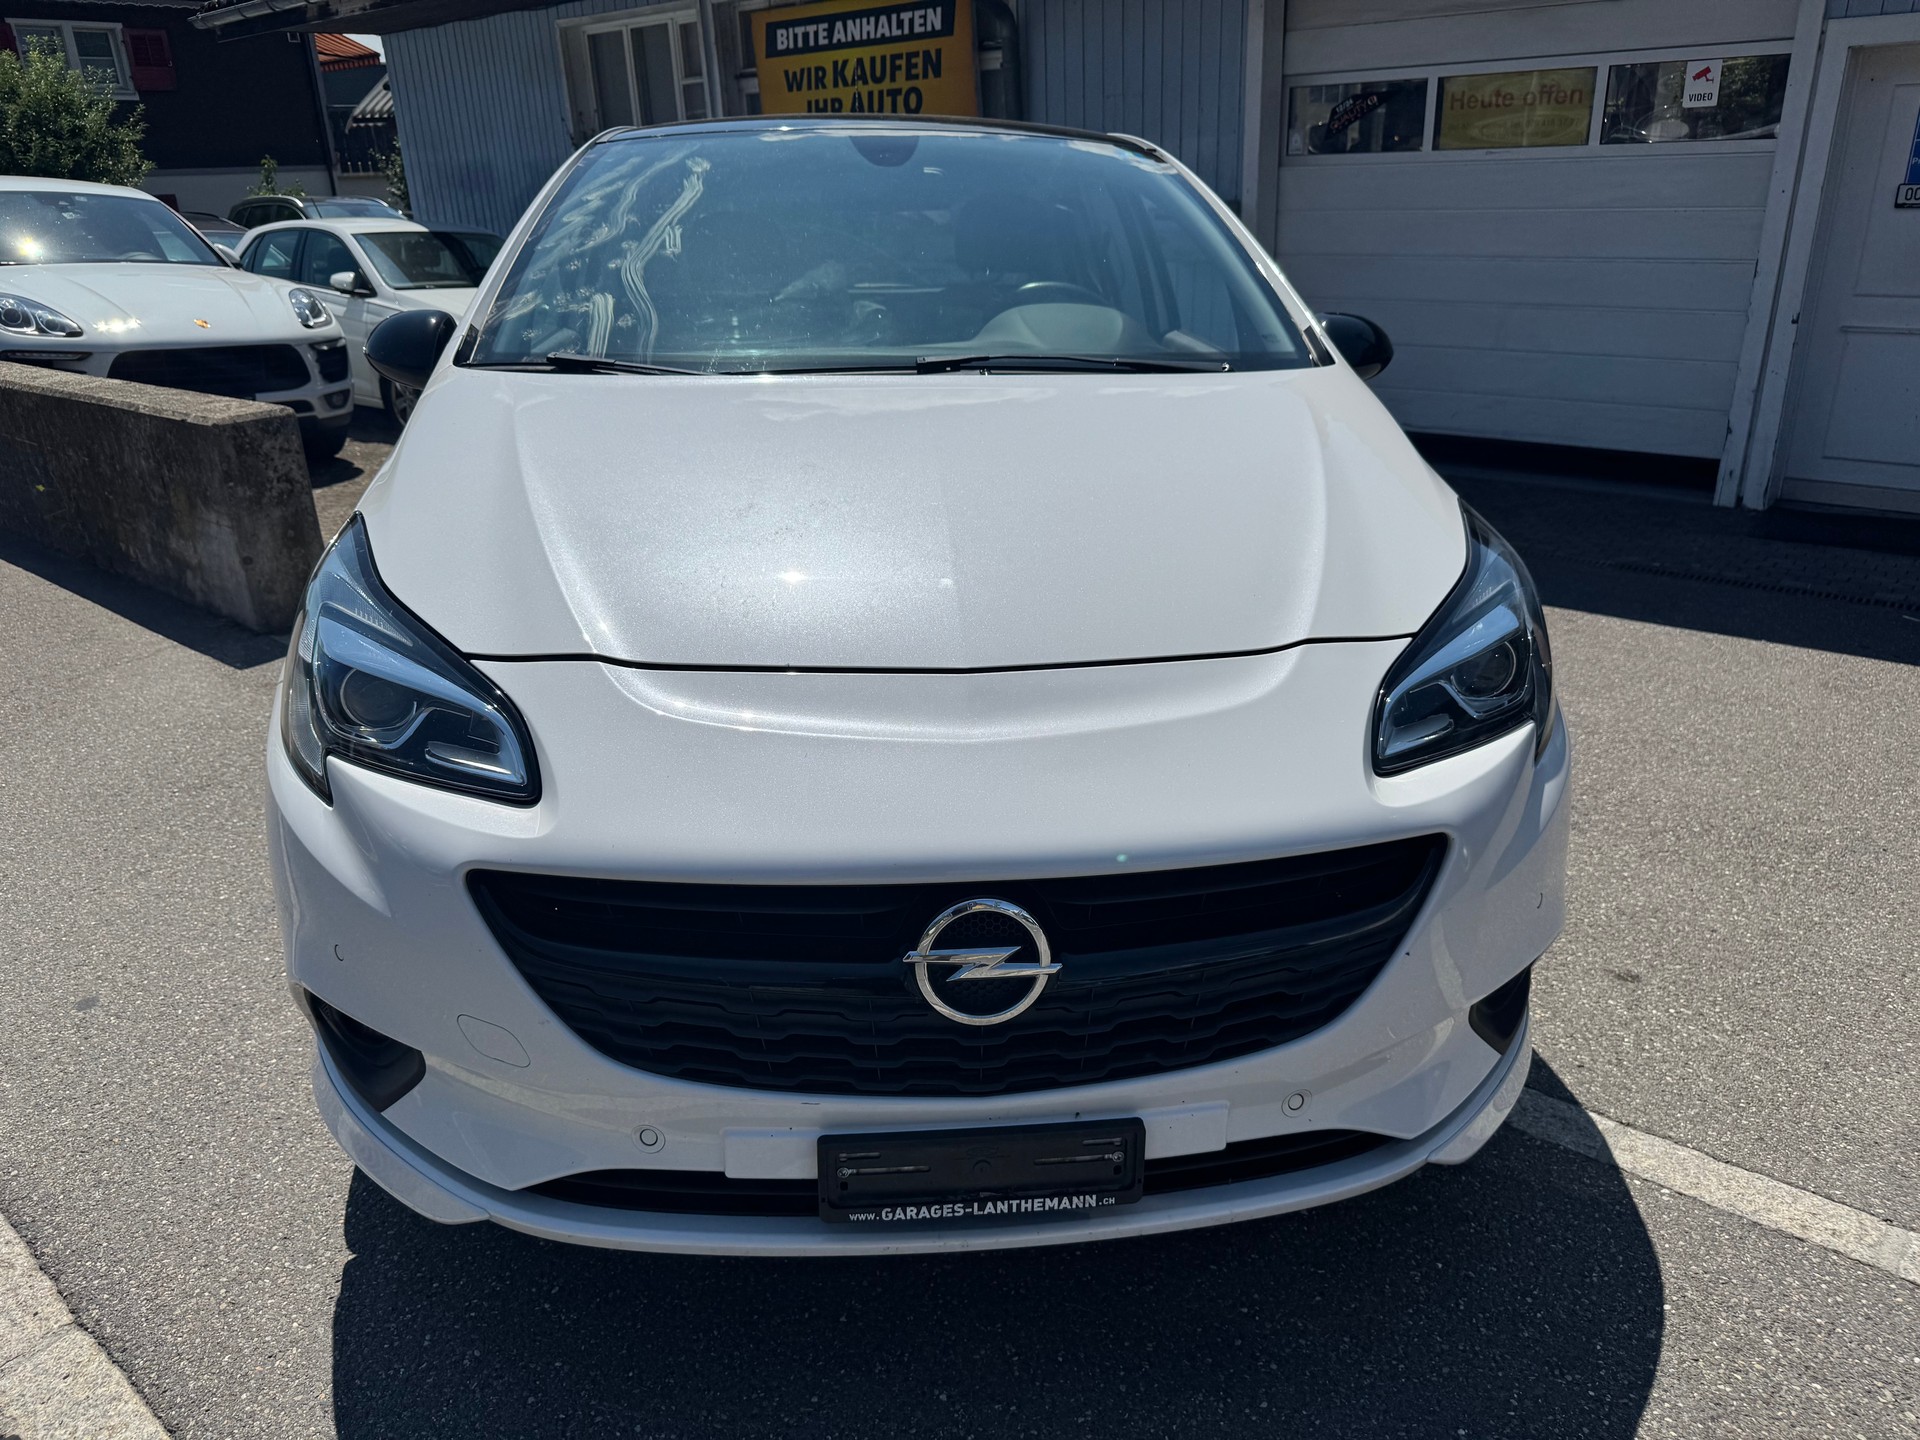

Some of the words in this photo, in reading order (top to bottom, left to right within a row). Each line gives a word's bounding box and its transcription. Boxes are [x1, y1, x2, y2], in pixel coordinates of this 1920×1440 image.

[776, 22, 829, 51] BITTE
[832, 6, 943, 44] ANHALTEN
[784, 65, 828, 93] WIR
[832, 48, 943, 89] KAUFEN
[849, 86, 924, 114] AUTO
[1450, 89, 1515, 111] Heute
[1522, 80, 1584, 107] offen
[1688, 92, 1713, 102] VIDEO
